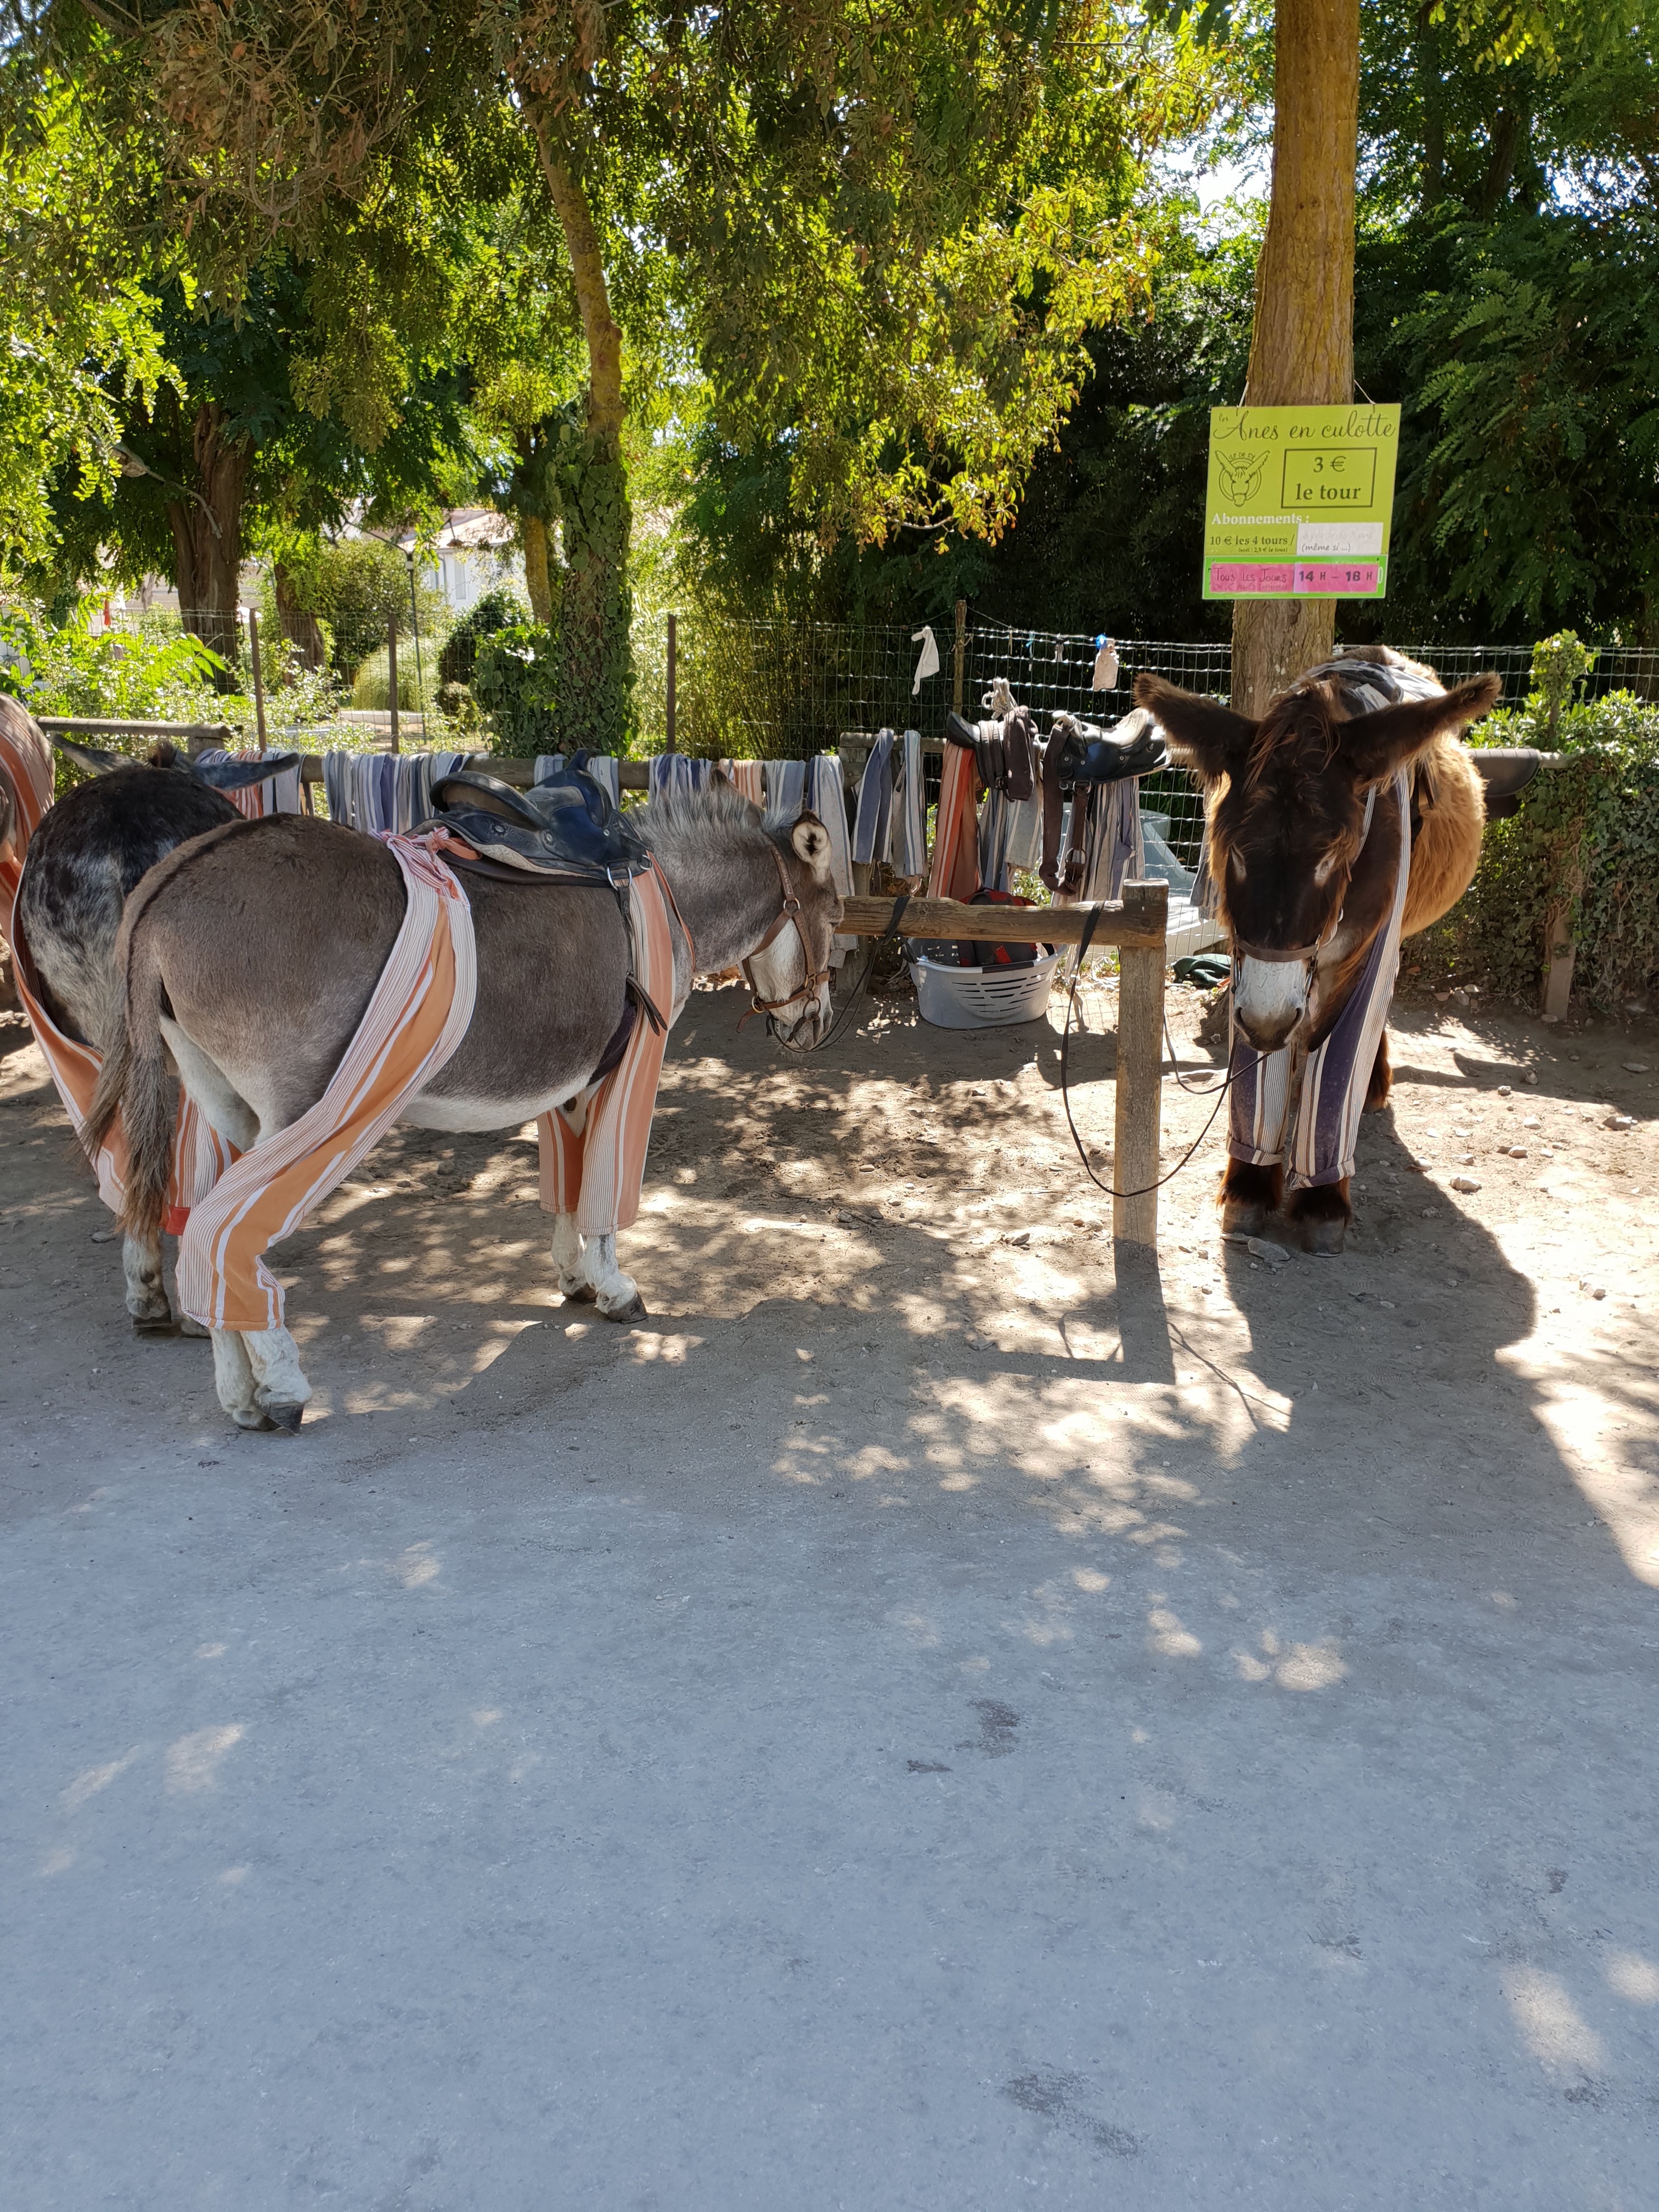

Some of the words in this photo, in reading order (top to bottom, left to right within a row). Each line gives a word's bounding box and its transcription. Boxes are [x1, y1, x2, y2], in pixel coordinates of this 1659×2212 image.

[1289, 425, 1315, 438] en
[1321, 410, 1396, 438] culotte
[1313, 456, 1323, 473] 3
[1330, 455, 1347, 472] €
[1295, 483, 1313, 500] le
[1320, 484, 1361, 500] tour
[1211, 512, 1302, 524] Abonnements
[1211, 536, 1221, 545] 10
[1224, 536, 1232, 545] €
[1235, 535, 1249, 545] les
[1252, 536, 1258, 545] 4
[1262, 536, 1288, 545] tours
[1302, 543, 1329, 553] (même
[1333, 543, 1339, 551] si
[1299, 571, 1314, 582] 14
[1320, 572, 1326, 580] H
[1346, 571, 1361, 582] 18
[1366, 572, 1372, 580] H
